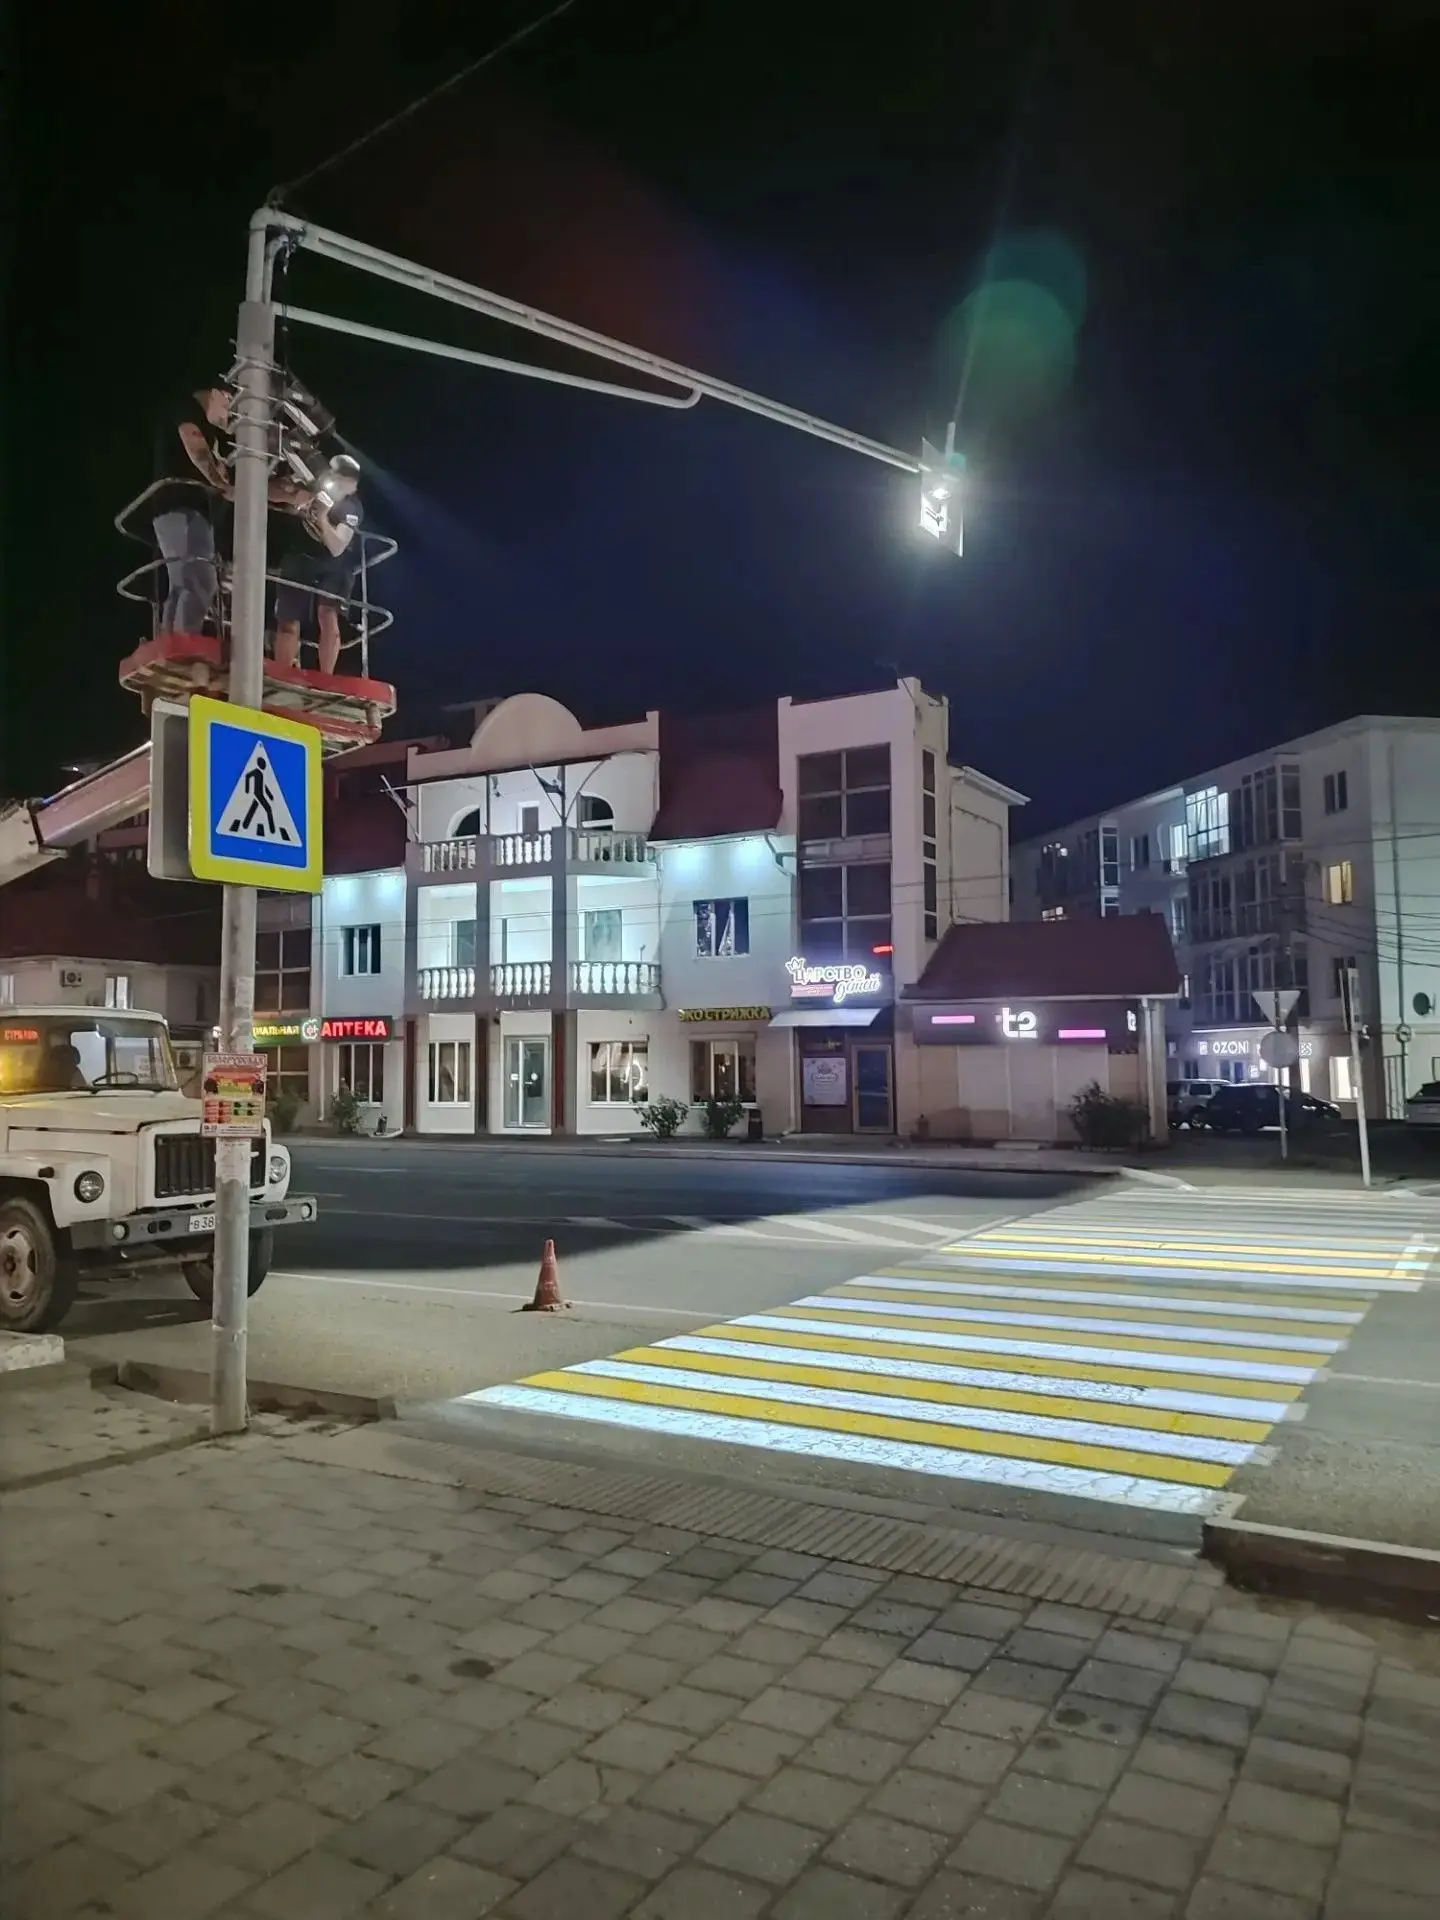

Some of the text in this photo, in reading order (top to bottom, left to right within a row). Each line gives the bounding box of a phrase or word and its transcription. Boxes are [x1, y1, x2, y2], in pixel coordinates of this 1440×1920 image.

[793, 965, 867, 985] ЦАРСТВО
[833, 973, 881, 1003] детей
[678, 1006, 771, 1022] ЭКОСТРИЖКА
[996, 1007, 1038, 1038] t2
[252, 1020, 387, 1037] ЦИАЛЬНАЯ АПТЕКА
[1212, 1041, 1246, 1055] OZON
[193, 1216, 214, 1230] В38
